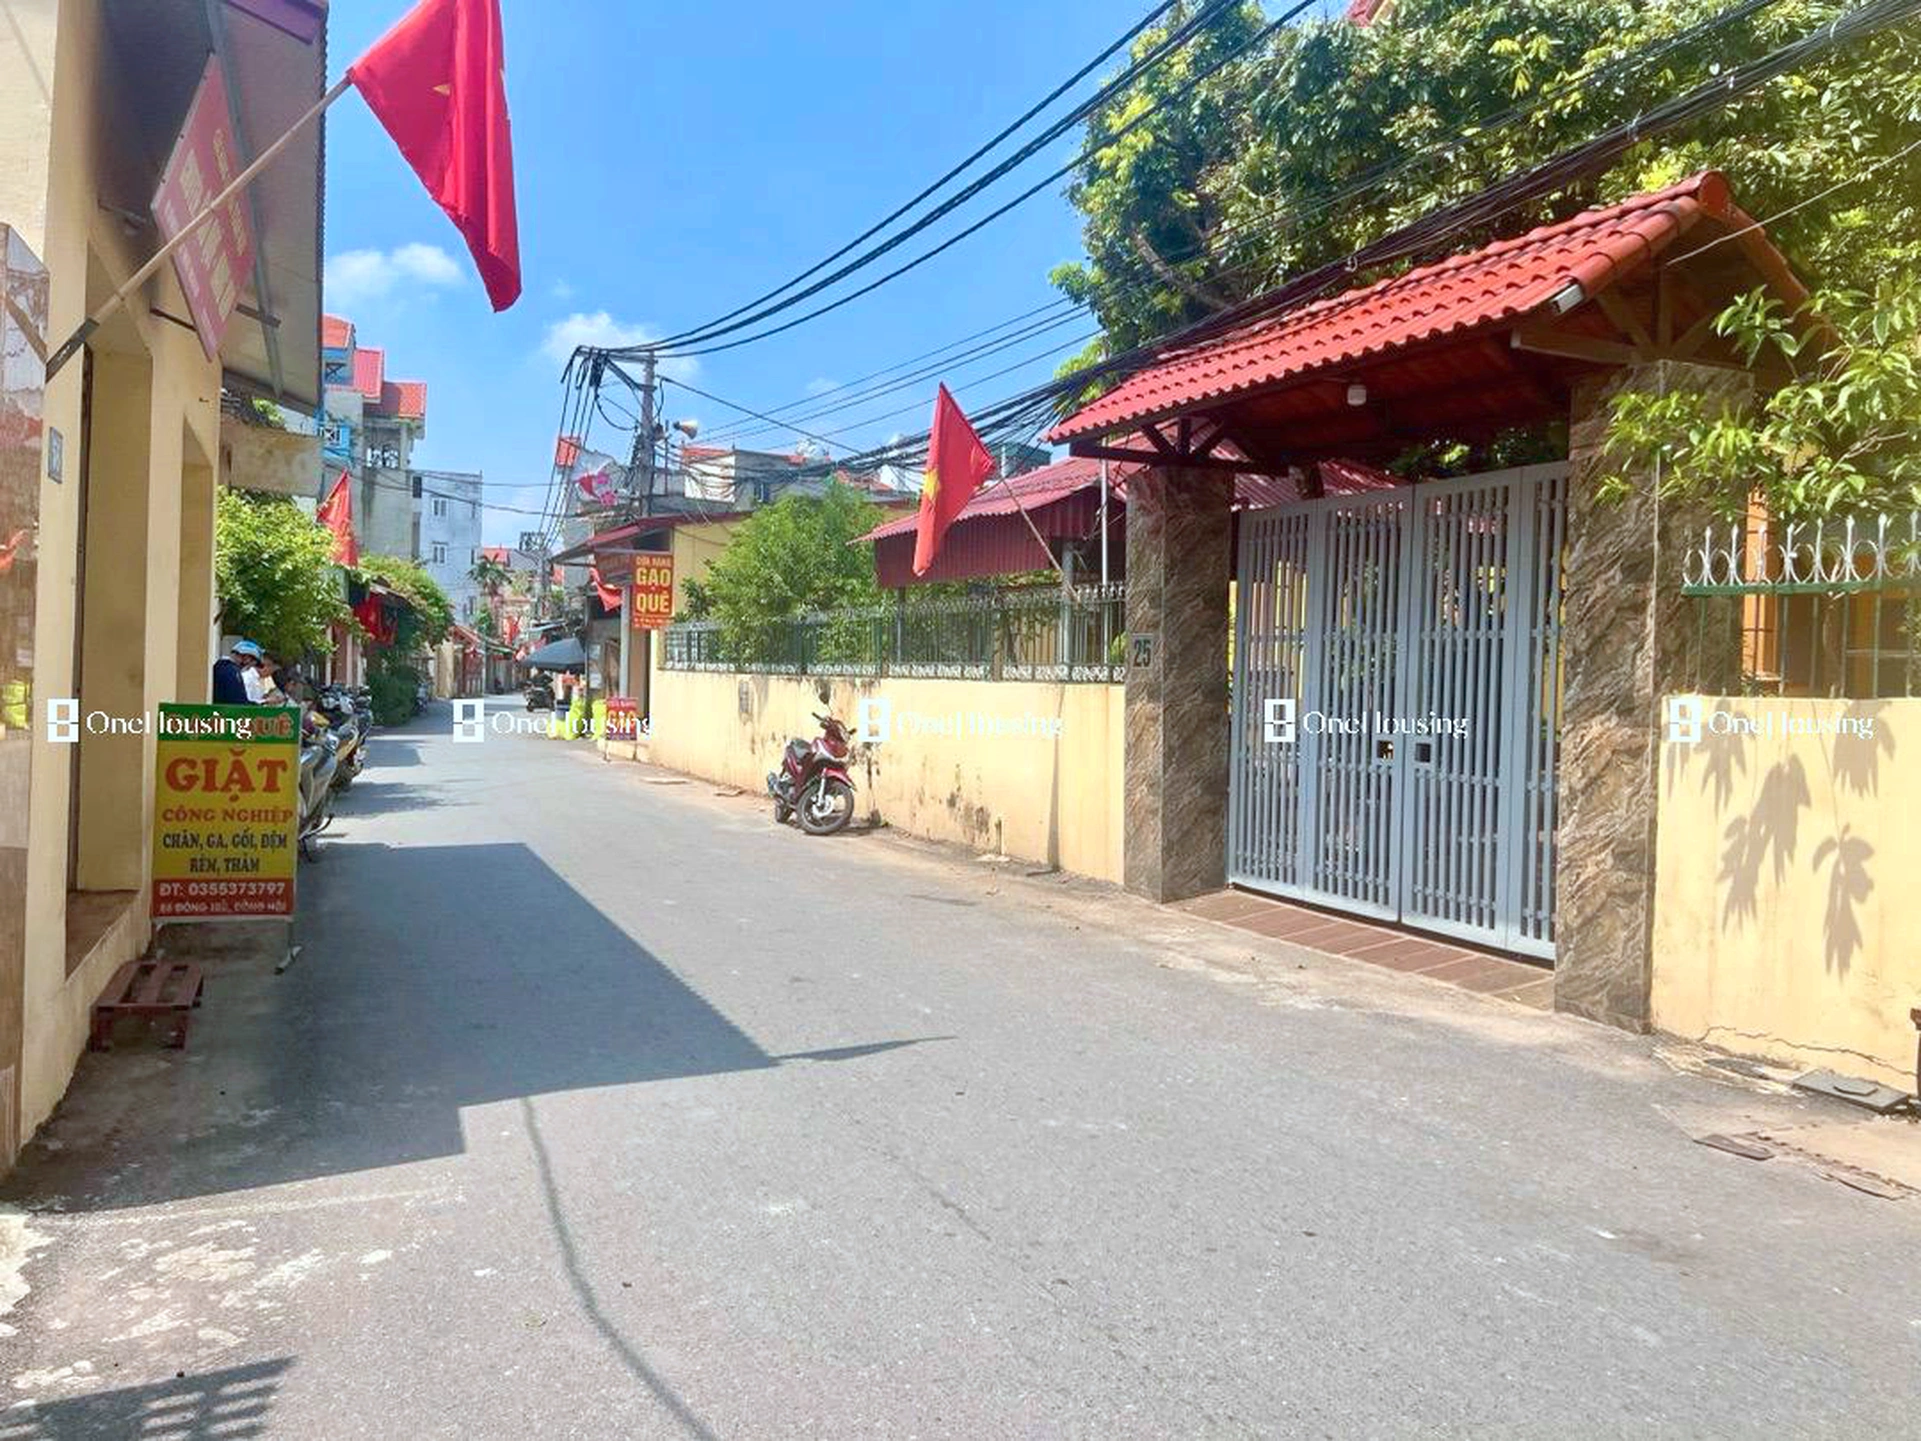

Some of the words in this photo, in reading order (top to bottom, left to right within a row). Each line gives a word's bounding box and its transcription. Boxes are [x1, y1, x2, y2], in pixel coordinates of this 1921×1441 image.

[636, 590, 670, 613] QUÊ
[1133, 639, 1151, 667] 25
[165, 747, 288, 802] GIẶT
[162, 805, 215, 822] CÔNG
[223, 805, 293, 825] NGHIỆP
